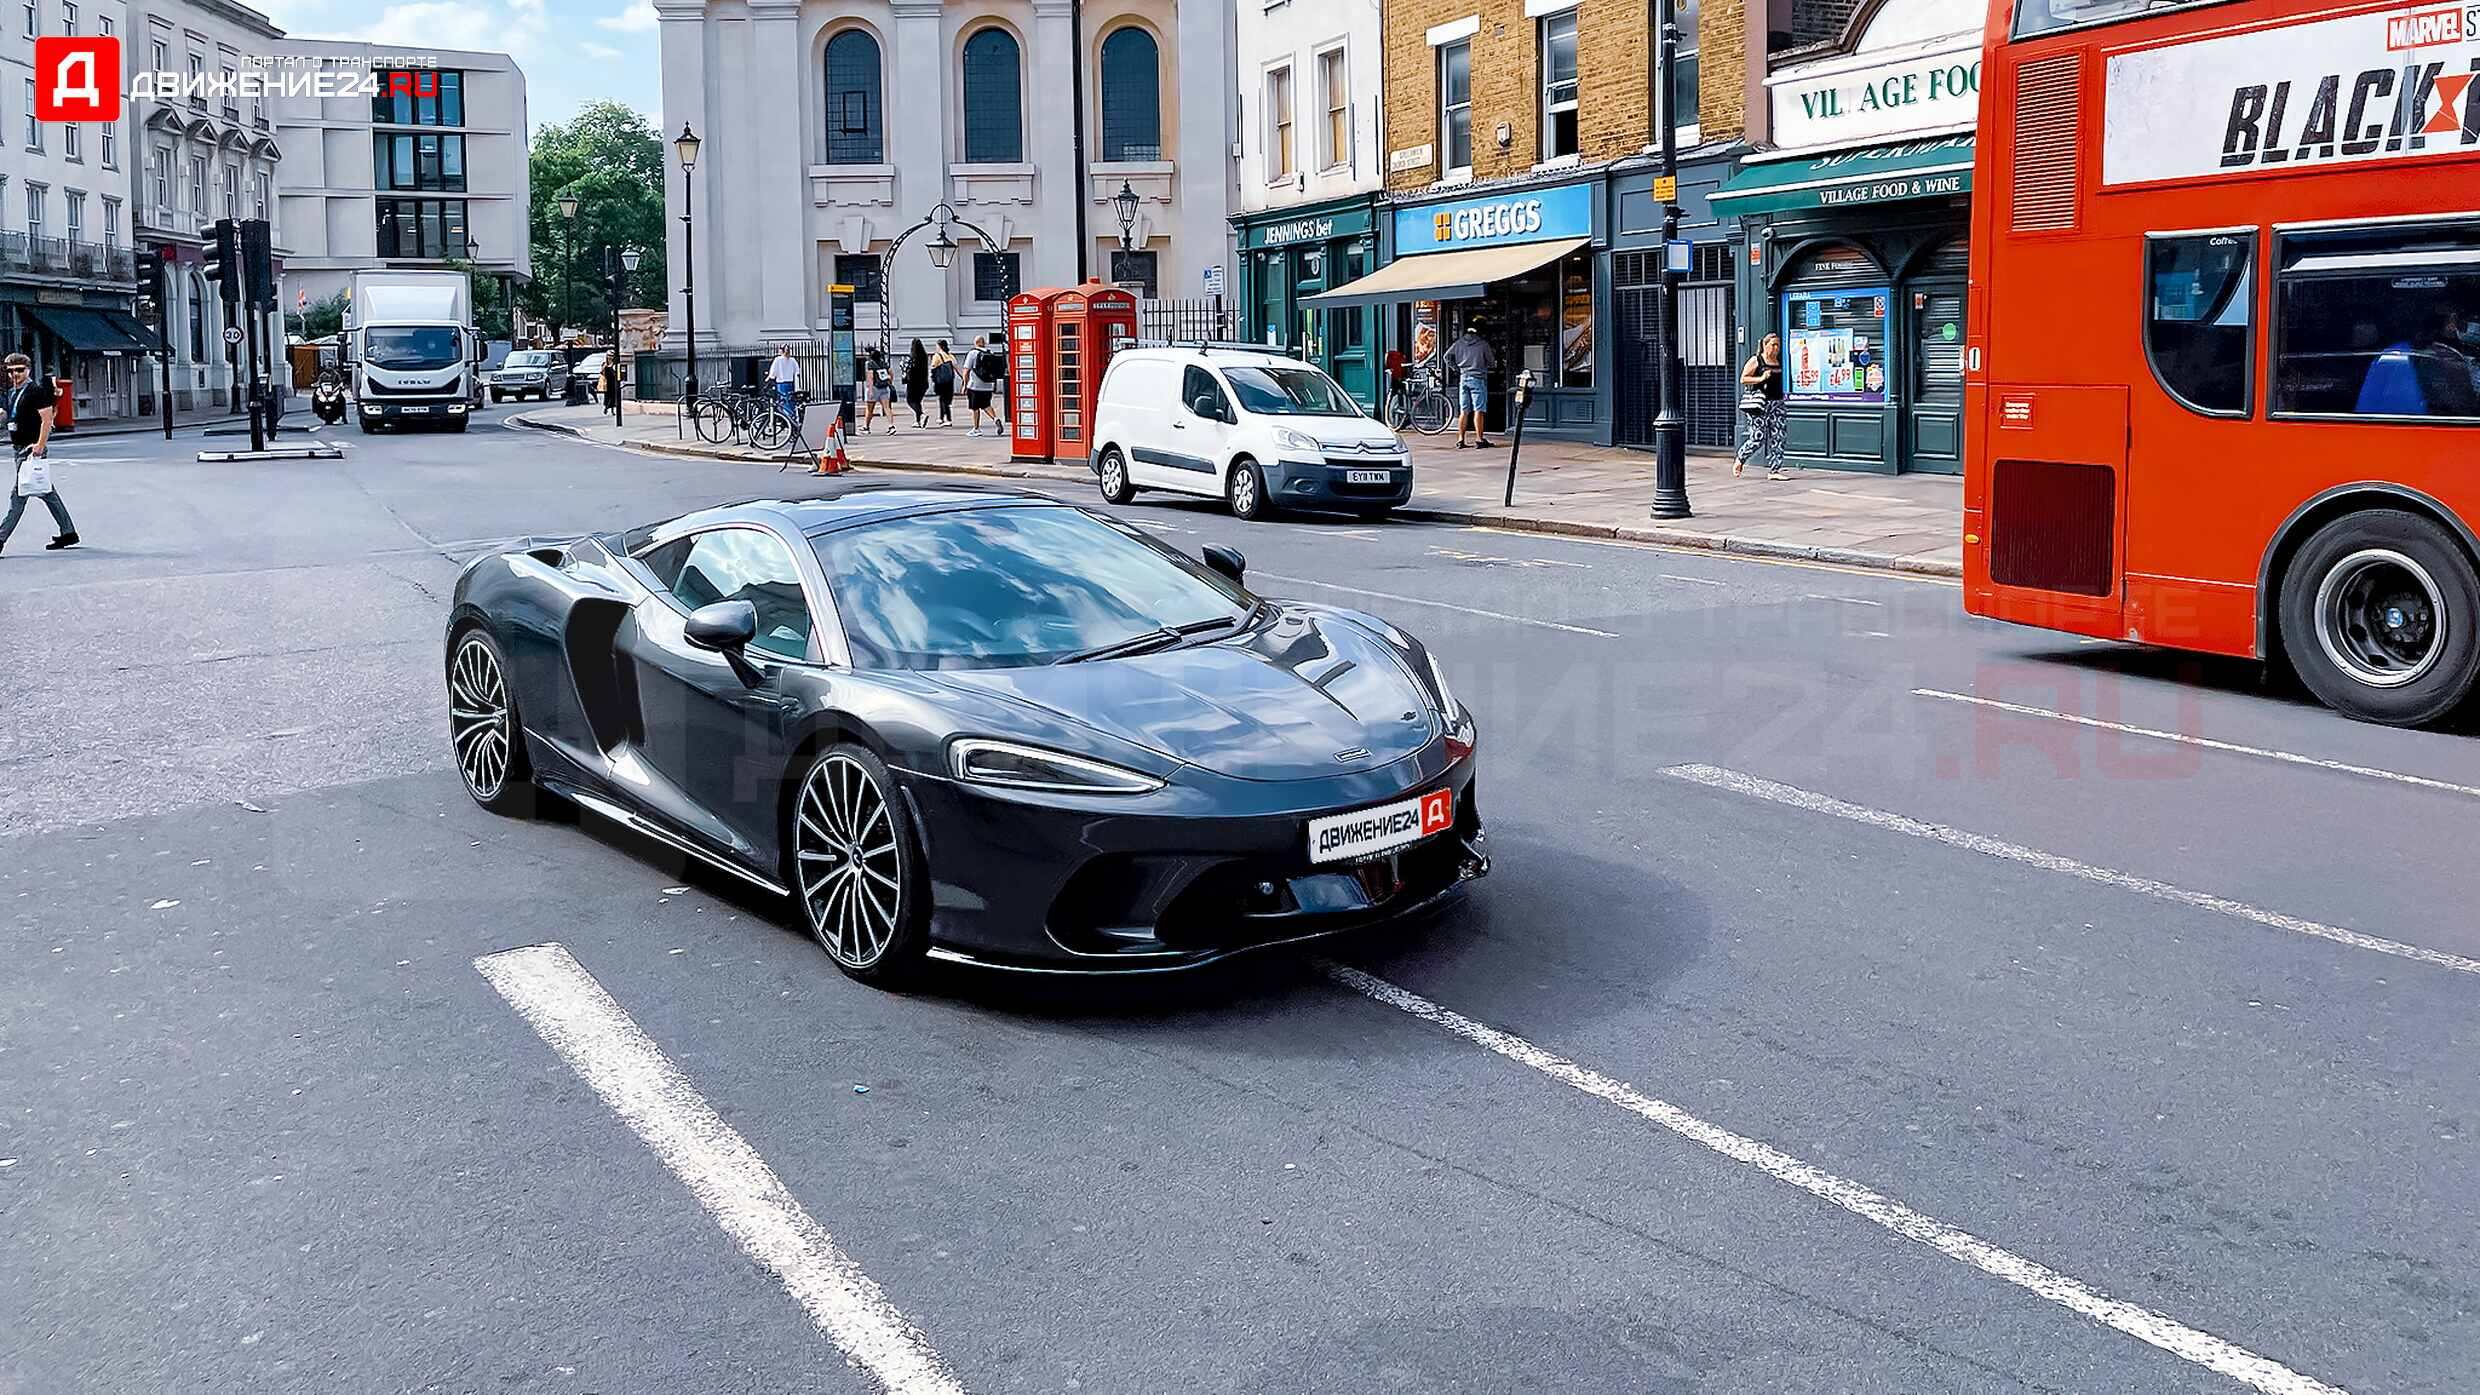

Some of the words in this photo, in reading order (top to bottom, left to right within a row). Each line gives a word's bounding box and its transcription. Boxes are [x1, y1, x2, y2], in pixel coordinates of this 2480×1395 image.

[2389, 11, 2460, 48] MARVEL
[2466, 10, 2480, 36] S
[2220, 62, 2445, 167] BLACK
[1820, 185, 1868, 204] VILLAGE
[1872, 182, 1908, 199] FOOD
[1912, 181, 1921, 195] &
[1926, 177, 1960, 193] WINE
[1264, 220, 1315, 245] JENNINGS
[1316, 218, 1333, 237] bet
[1455, 199, 1541, 240] GREGGS
[226, 330, 240, 340] 30
[1319, 808, 1419, 853] ДВИЖЕНИЕ24
[1427, 799, 1445, 827] Д
